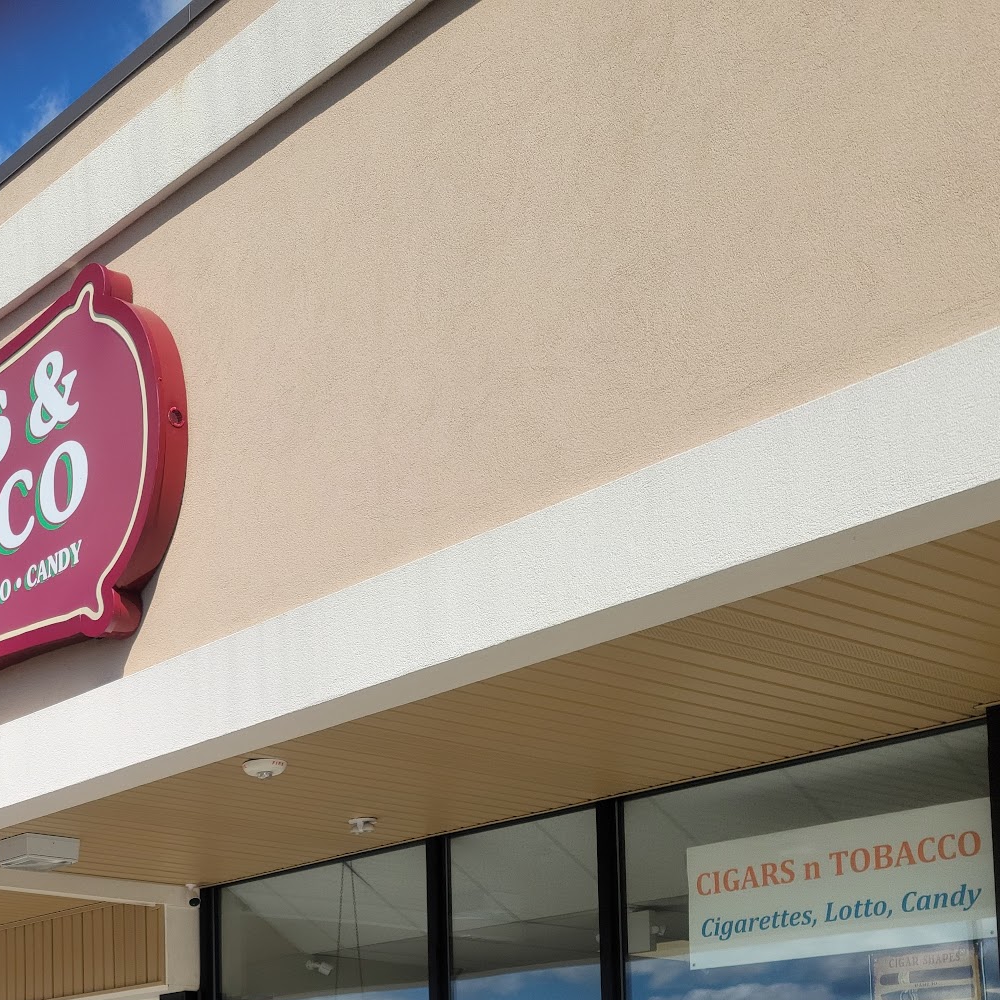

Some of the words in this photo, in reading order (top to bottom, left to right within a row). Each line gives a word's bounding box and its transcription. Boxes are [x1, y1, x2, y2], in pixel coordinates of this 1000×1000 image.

[26, 350, 80, 444] &
[24, 539, 83, 591] CANDY
[696, 859, 796, 896] CIGARS
[803, 861, 821, 881] n
[829, 830, 982, 877] TOBACCO
[701, 908, 818, 942] Cigarettes,
[825, 898, 893, 923] Lotto,
[901, 884, 982, 915] Candy
[889, 956, 921, 969] CIGAR
[923, 952, 961, 965] SHAPES
